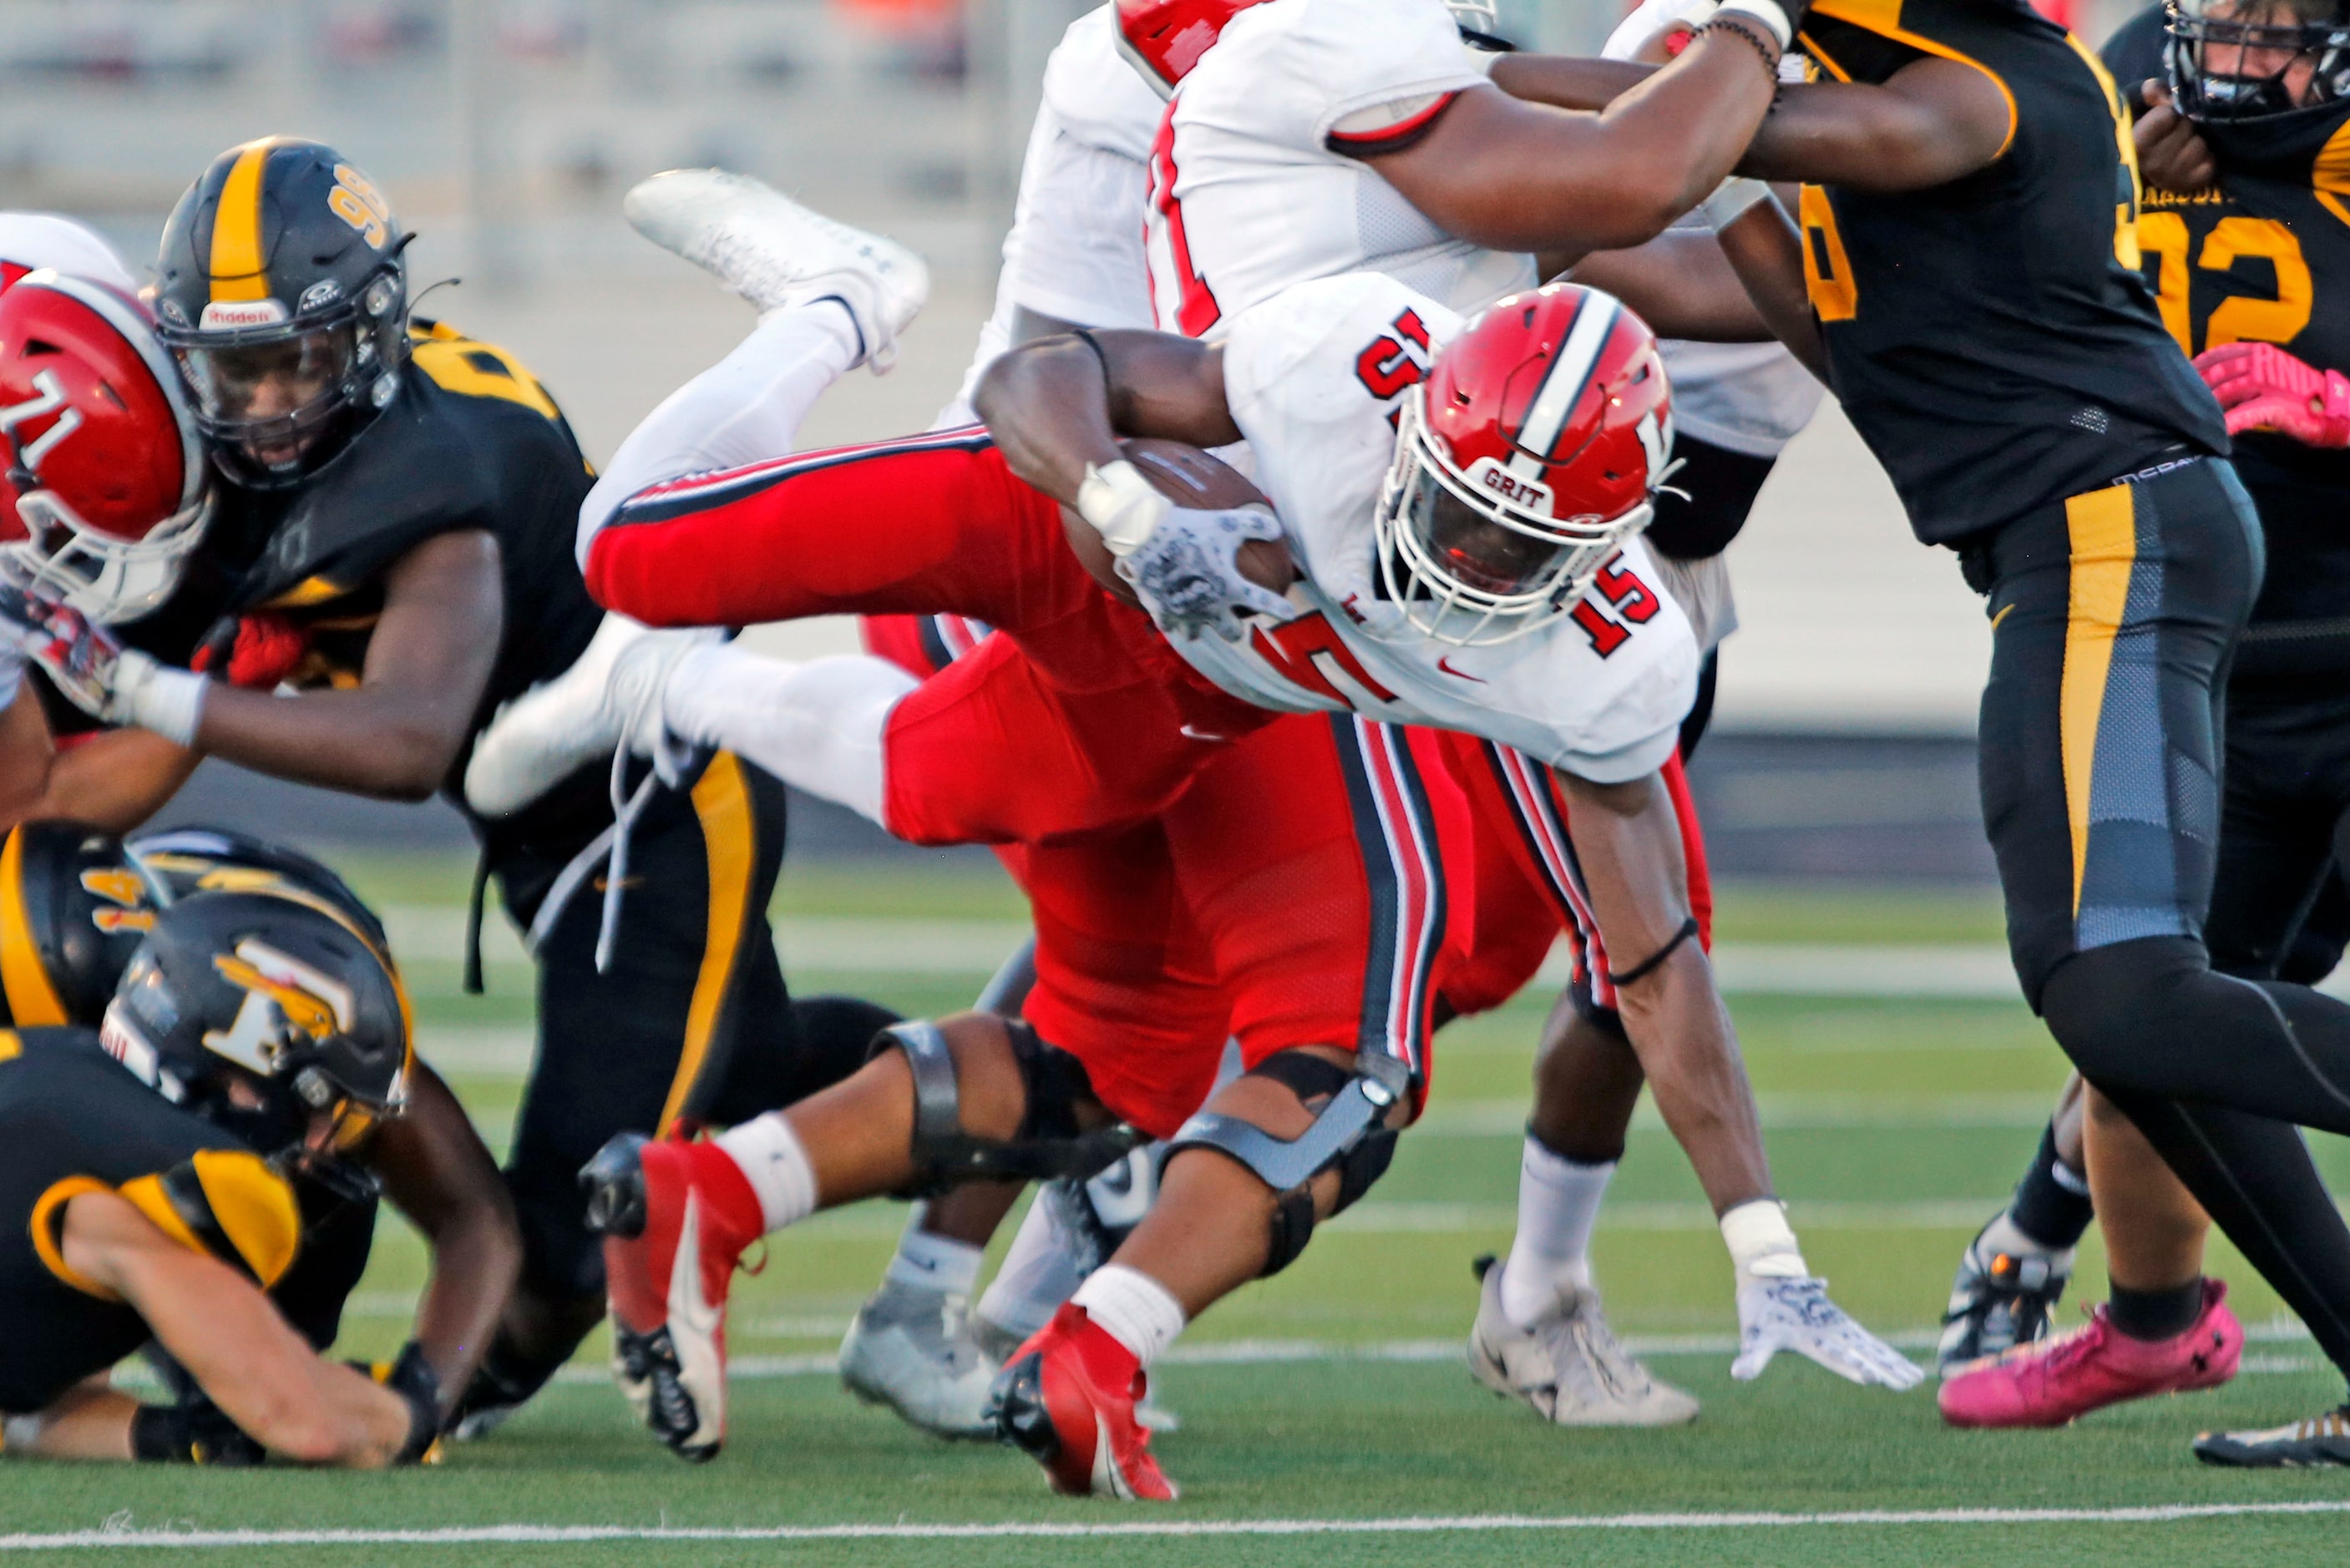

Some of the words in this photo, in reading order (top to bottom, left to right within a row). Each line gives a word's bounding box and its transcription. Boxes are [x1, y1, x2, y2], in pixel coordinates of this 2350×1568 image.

[327, 163, 389, 250] 98
[0, 369, 83, 470] 71
[1484, 468, 1545, 508] GRIT
[1568, 549, 1660, 660] 15
